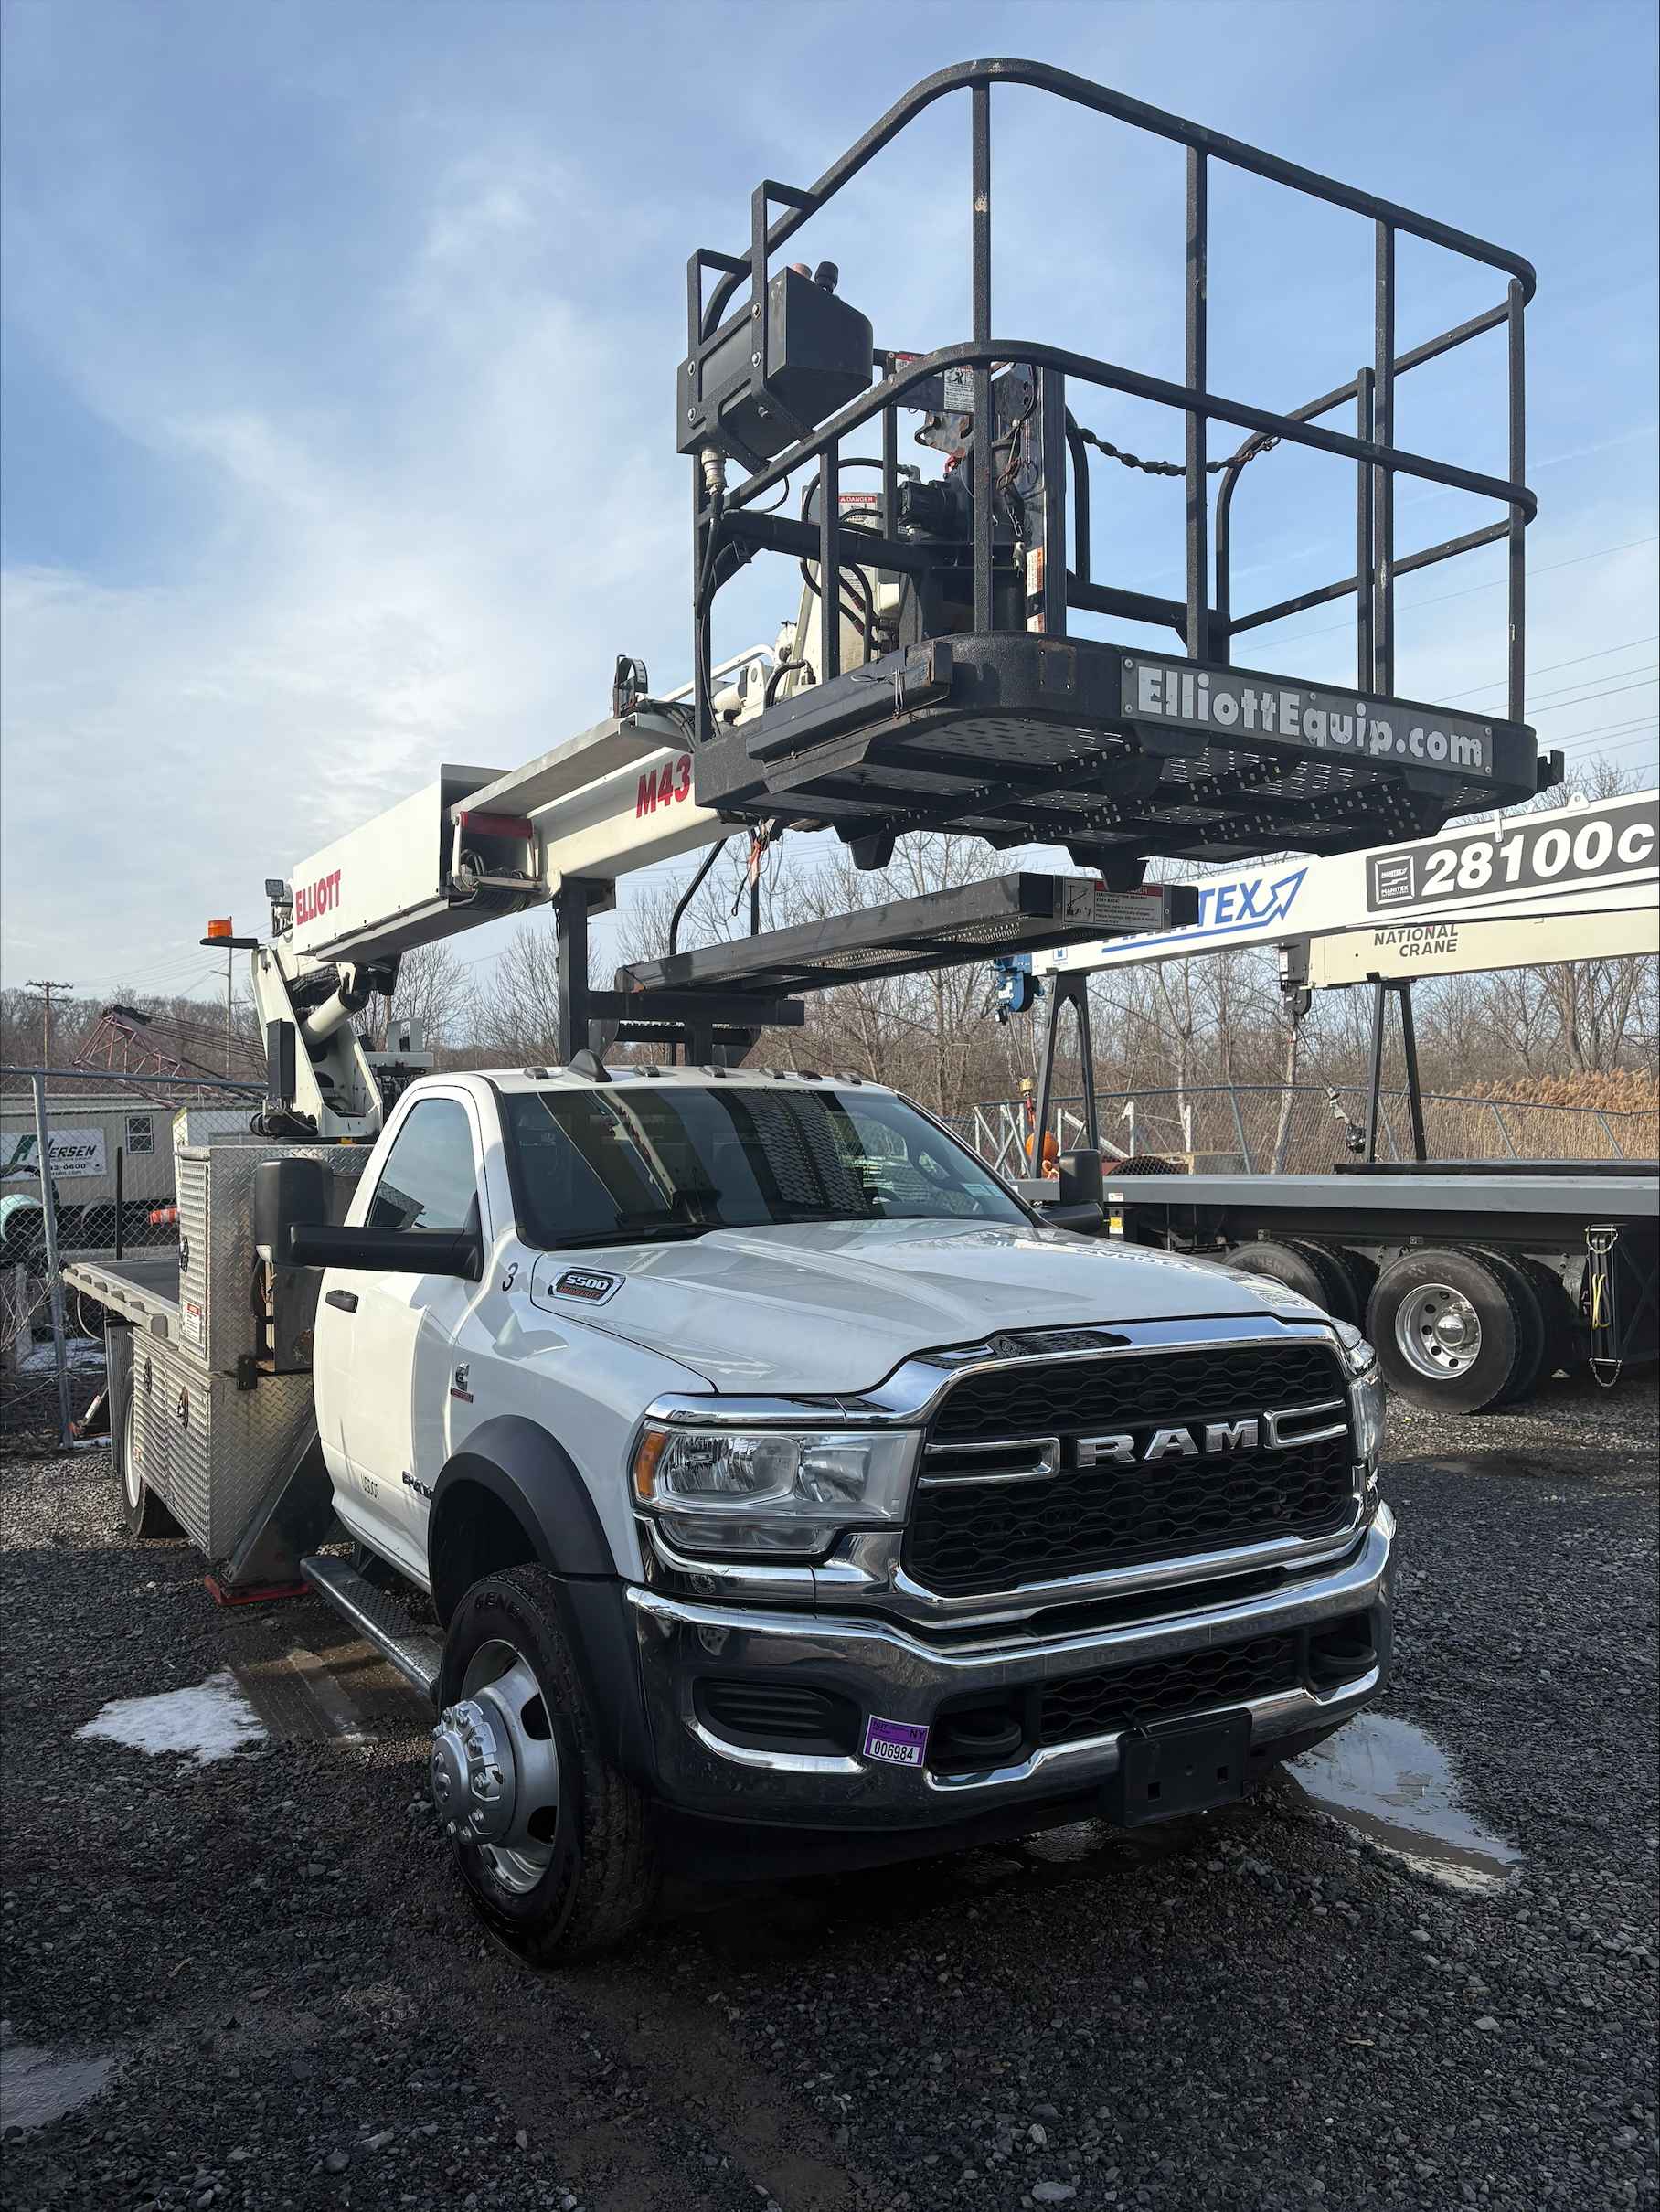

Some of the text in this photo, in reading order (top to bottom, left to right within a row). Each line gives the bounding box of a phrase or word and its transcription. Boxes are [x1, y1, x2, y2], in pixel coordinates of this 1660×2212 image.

[1138, 665, 1483, 768] ElliottEquip.com
[636, 754, 691, 819] M43
[1421, 821, 1655, 897] 28100c
[295, 869, 341, 926] ELLIOTT
[1374, 924, 1459, 947] NATIONAL
[1399, 939, 1458, 958] CRANE
[502, 1262, 518, 1292] 3
[566, 1274, 609, 1290] 5500
[1076, 1419, 1259, 1468] RAM
[910, 1728, 925, 1739] NY
[874, 1740, 913, 1761] 006984
